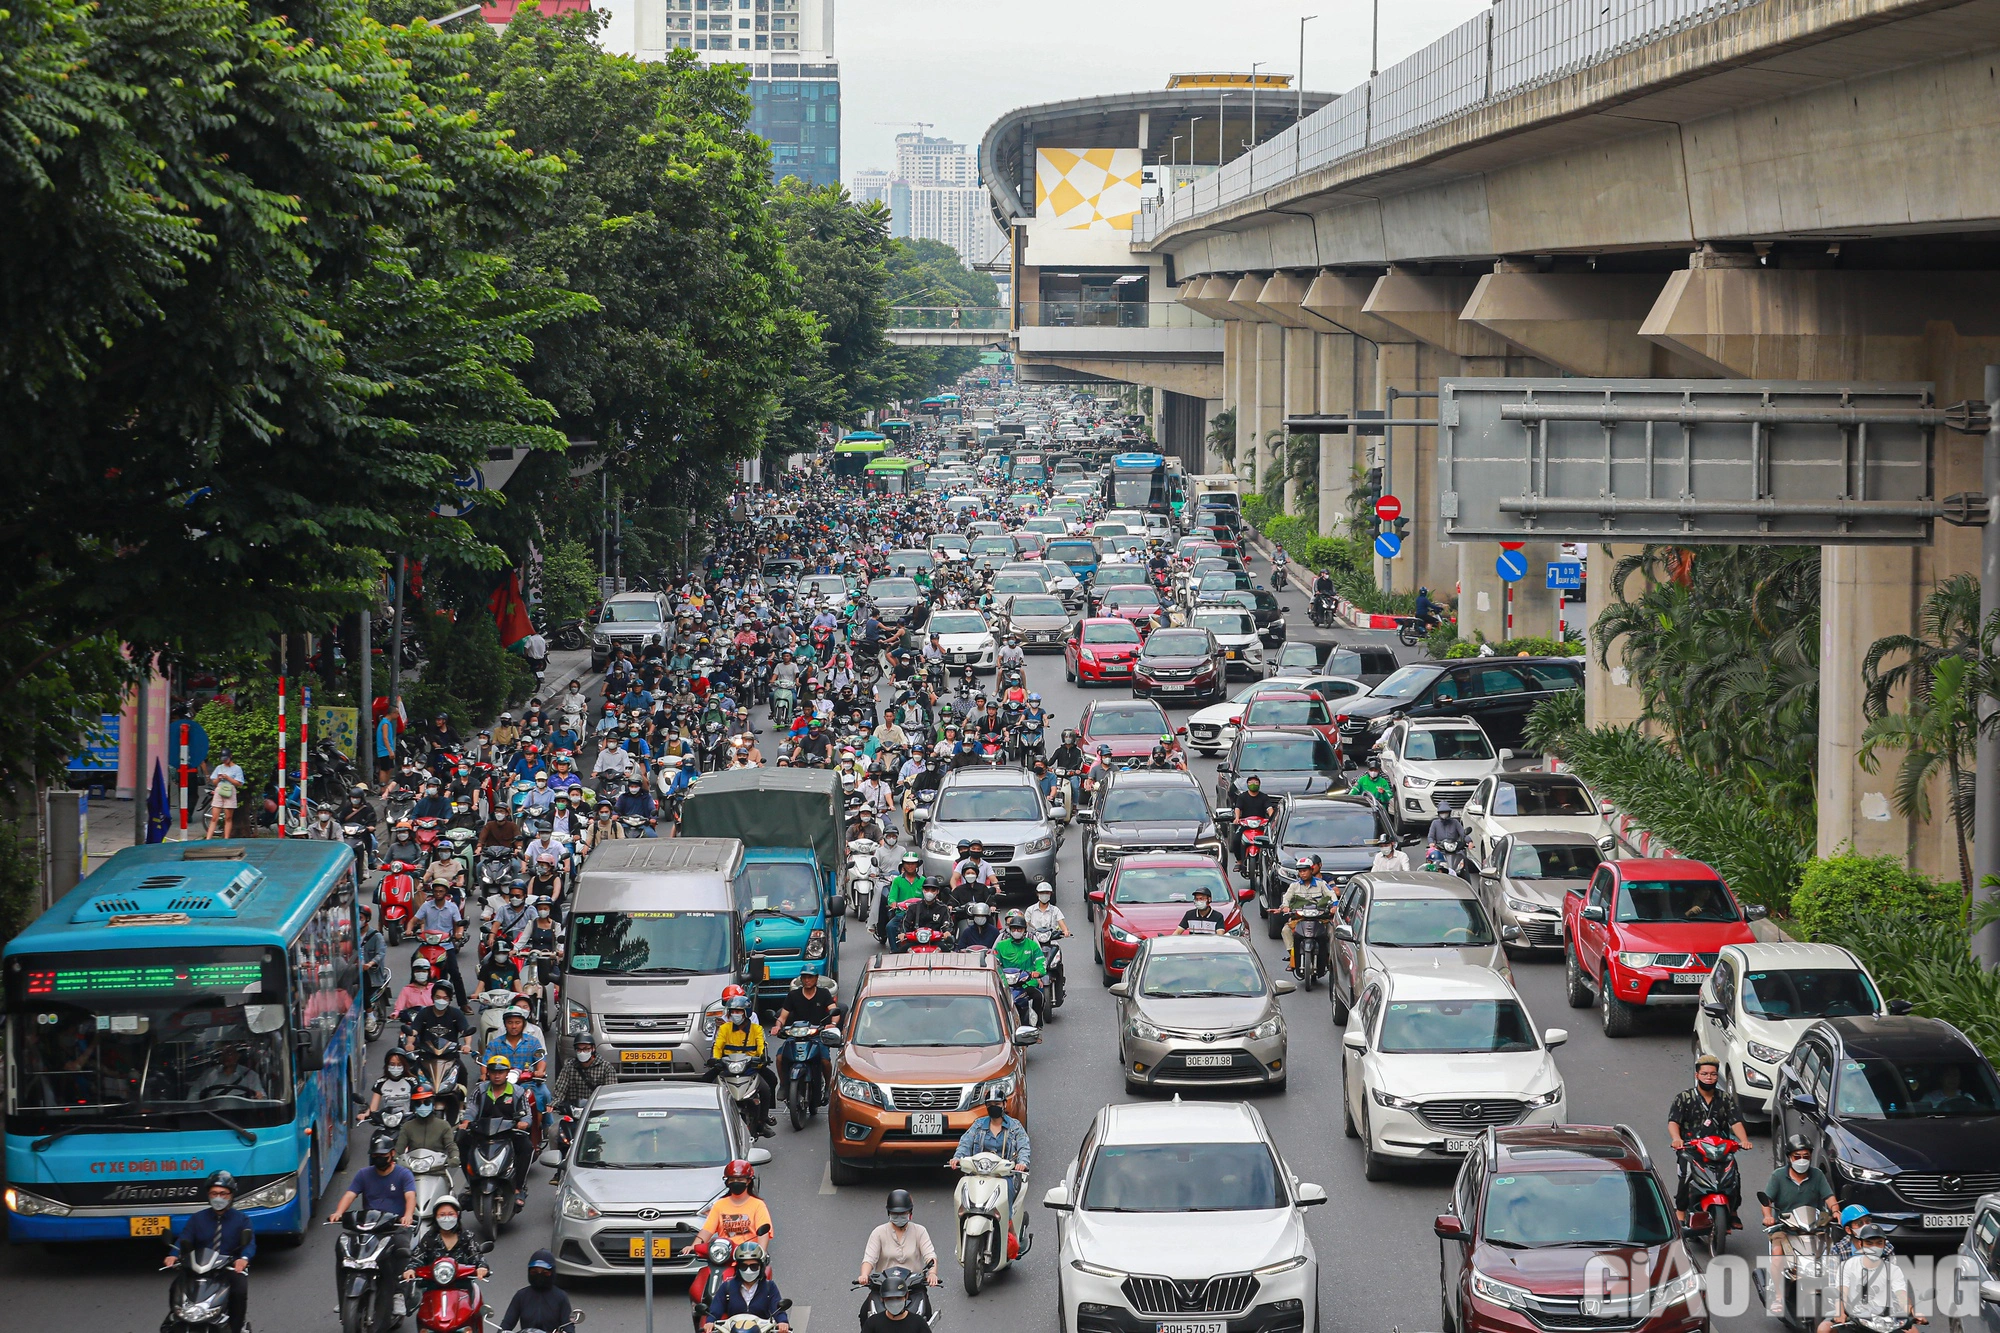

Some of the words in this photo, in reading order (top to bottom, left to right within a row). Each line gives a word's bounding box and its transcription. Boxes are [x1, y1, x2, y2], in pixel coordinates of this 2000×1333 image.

[625, 1052, 667, 1060] 29B-626.20
[1187, 1056, 1231, 1066] 30E-871.98
[919, 1114, 936, 1124] 29H
[912, 1124, 941, 1134] 041.77
[90, 1161, 106, 1174] CT
[110, 1161, 125, 1173] XE
[128, 1158, 157, 1175] ĐIỆN
[161, 1157, 177, 1172] HÀ
[181, 1156, 204, 1174] NỘI
[142, 1217, 159, 1226] 29B
[634, 1249, 666, 1258] 68.25
[1163, 1323, 1221, 1333] 30H-570.57
